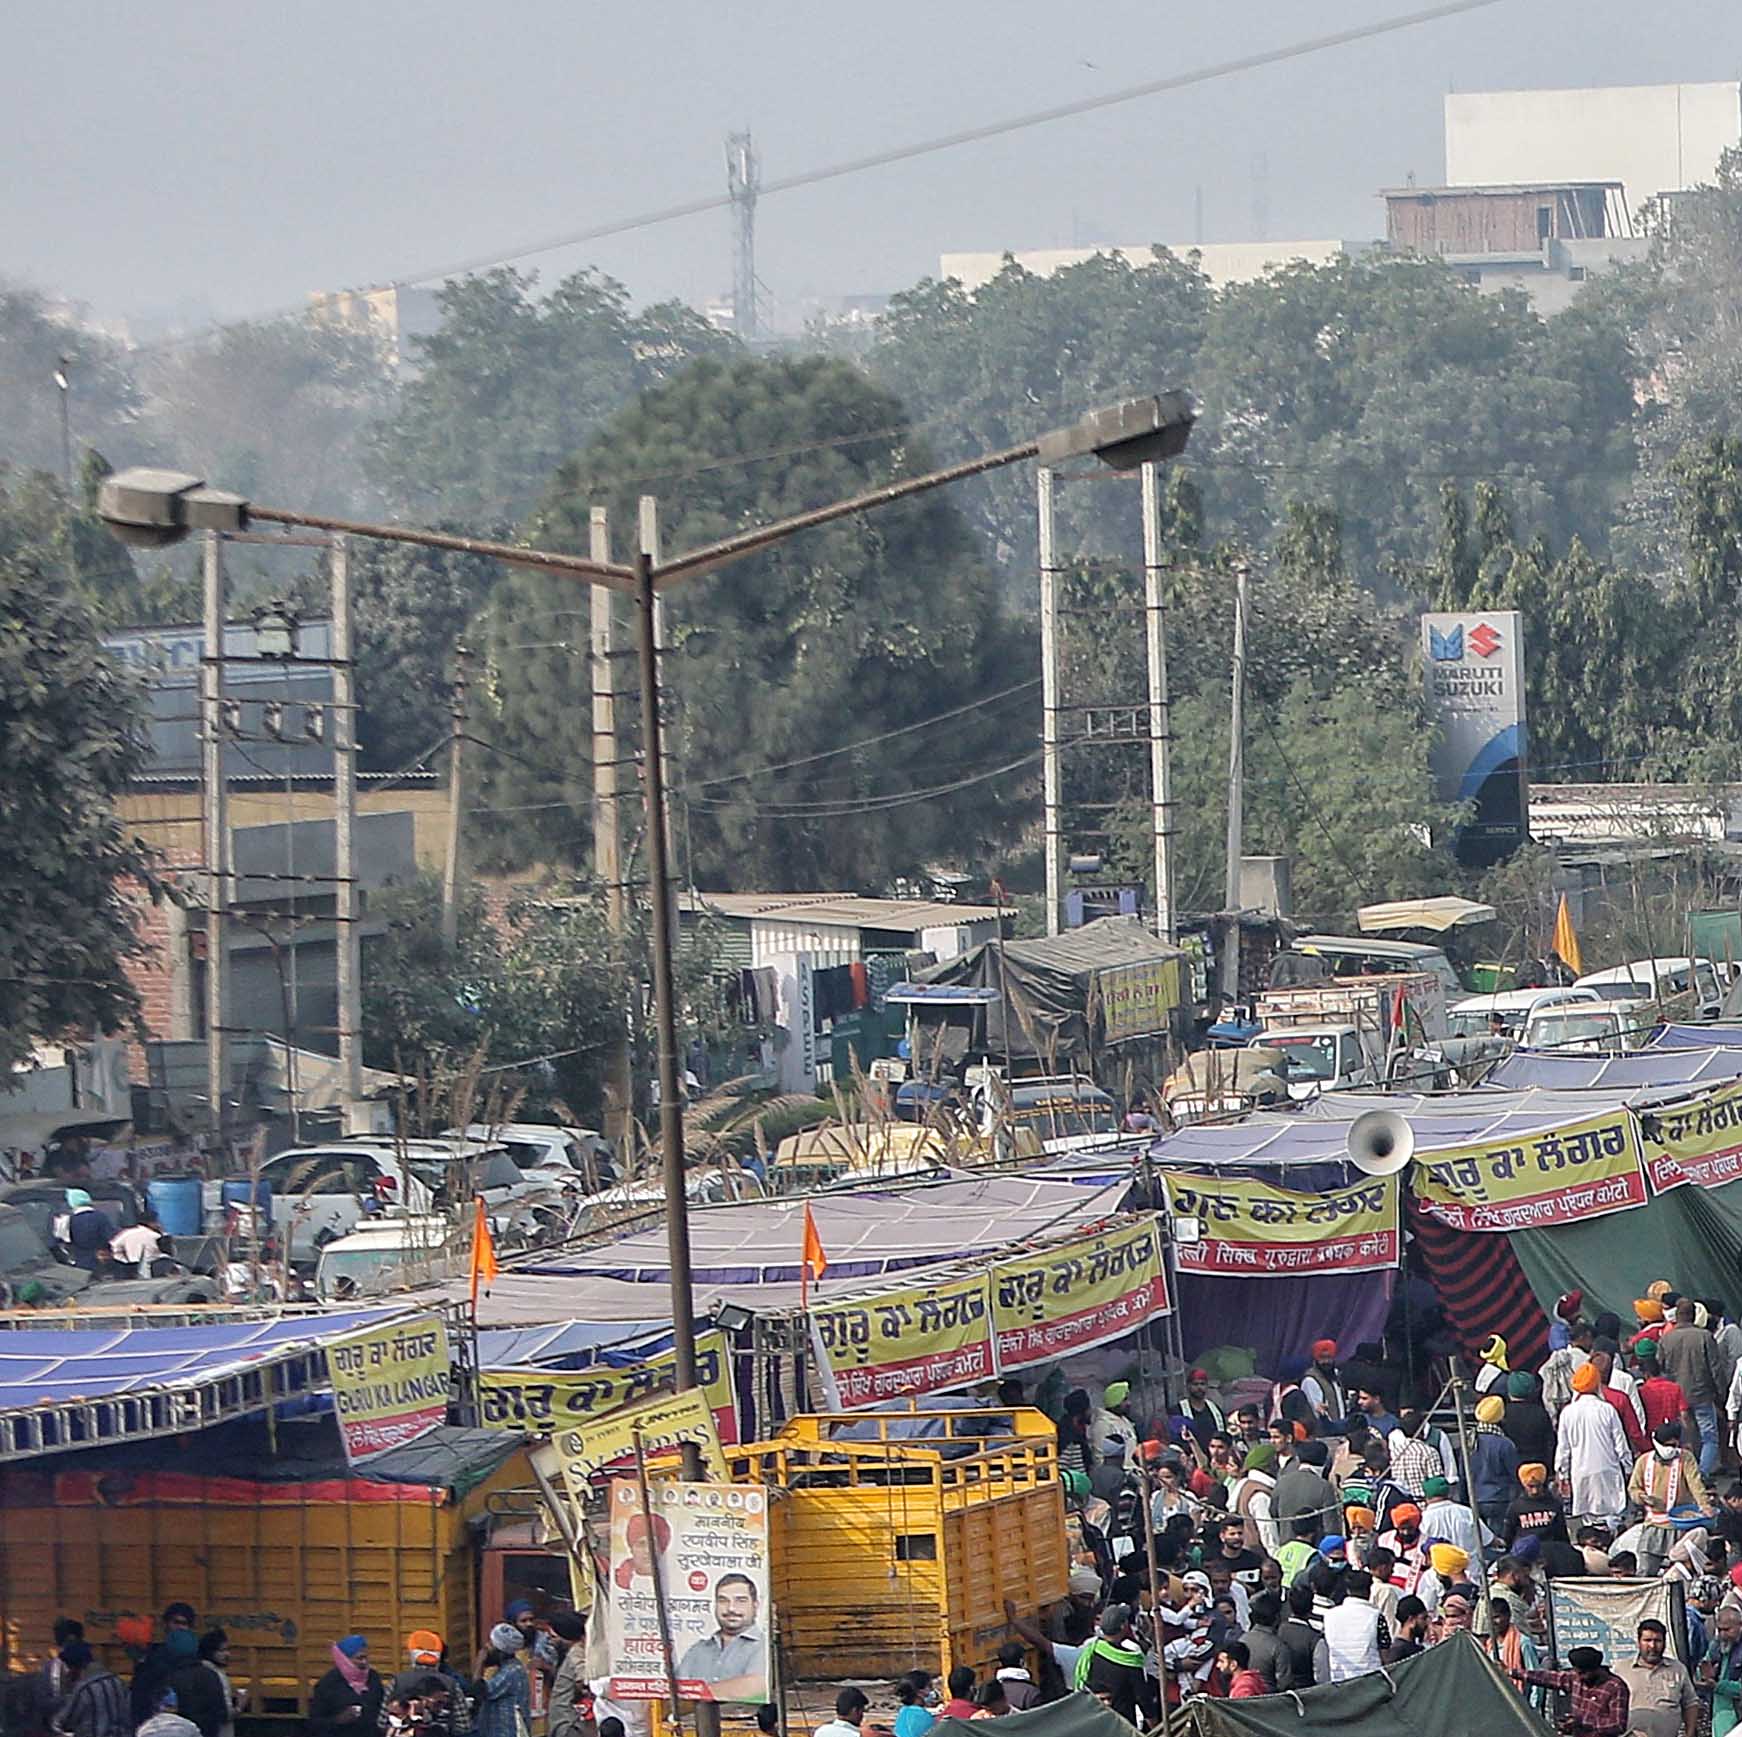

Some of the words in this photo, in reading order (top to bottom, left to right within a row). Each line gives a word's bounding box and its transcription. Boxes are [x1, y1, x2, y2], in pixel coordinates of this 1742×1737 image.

[1433, 667, 1503, 681] MARUTI
[1433, 681, 1503, 696] SUZUKI
[1248, 1197, 1296, 1224] का
[337, 1389, 374, 1414] GURU
[375, 1386, 394, 1409] KA
[395, 1371, 449, 1402] LANGAR
